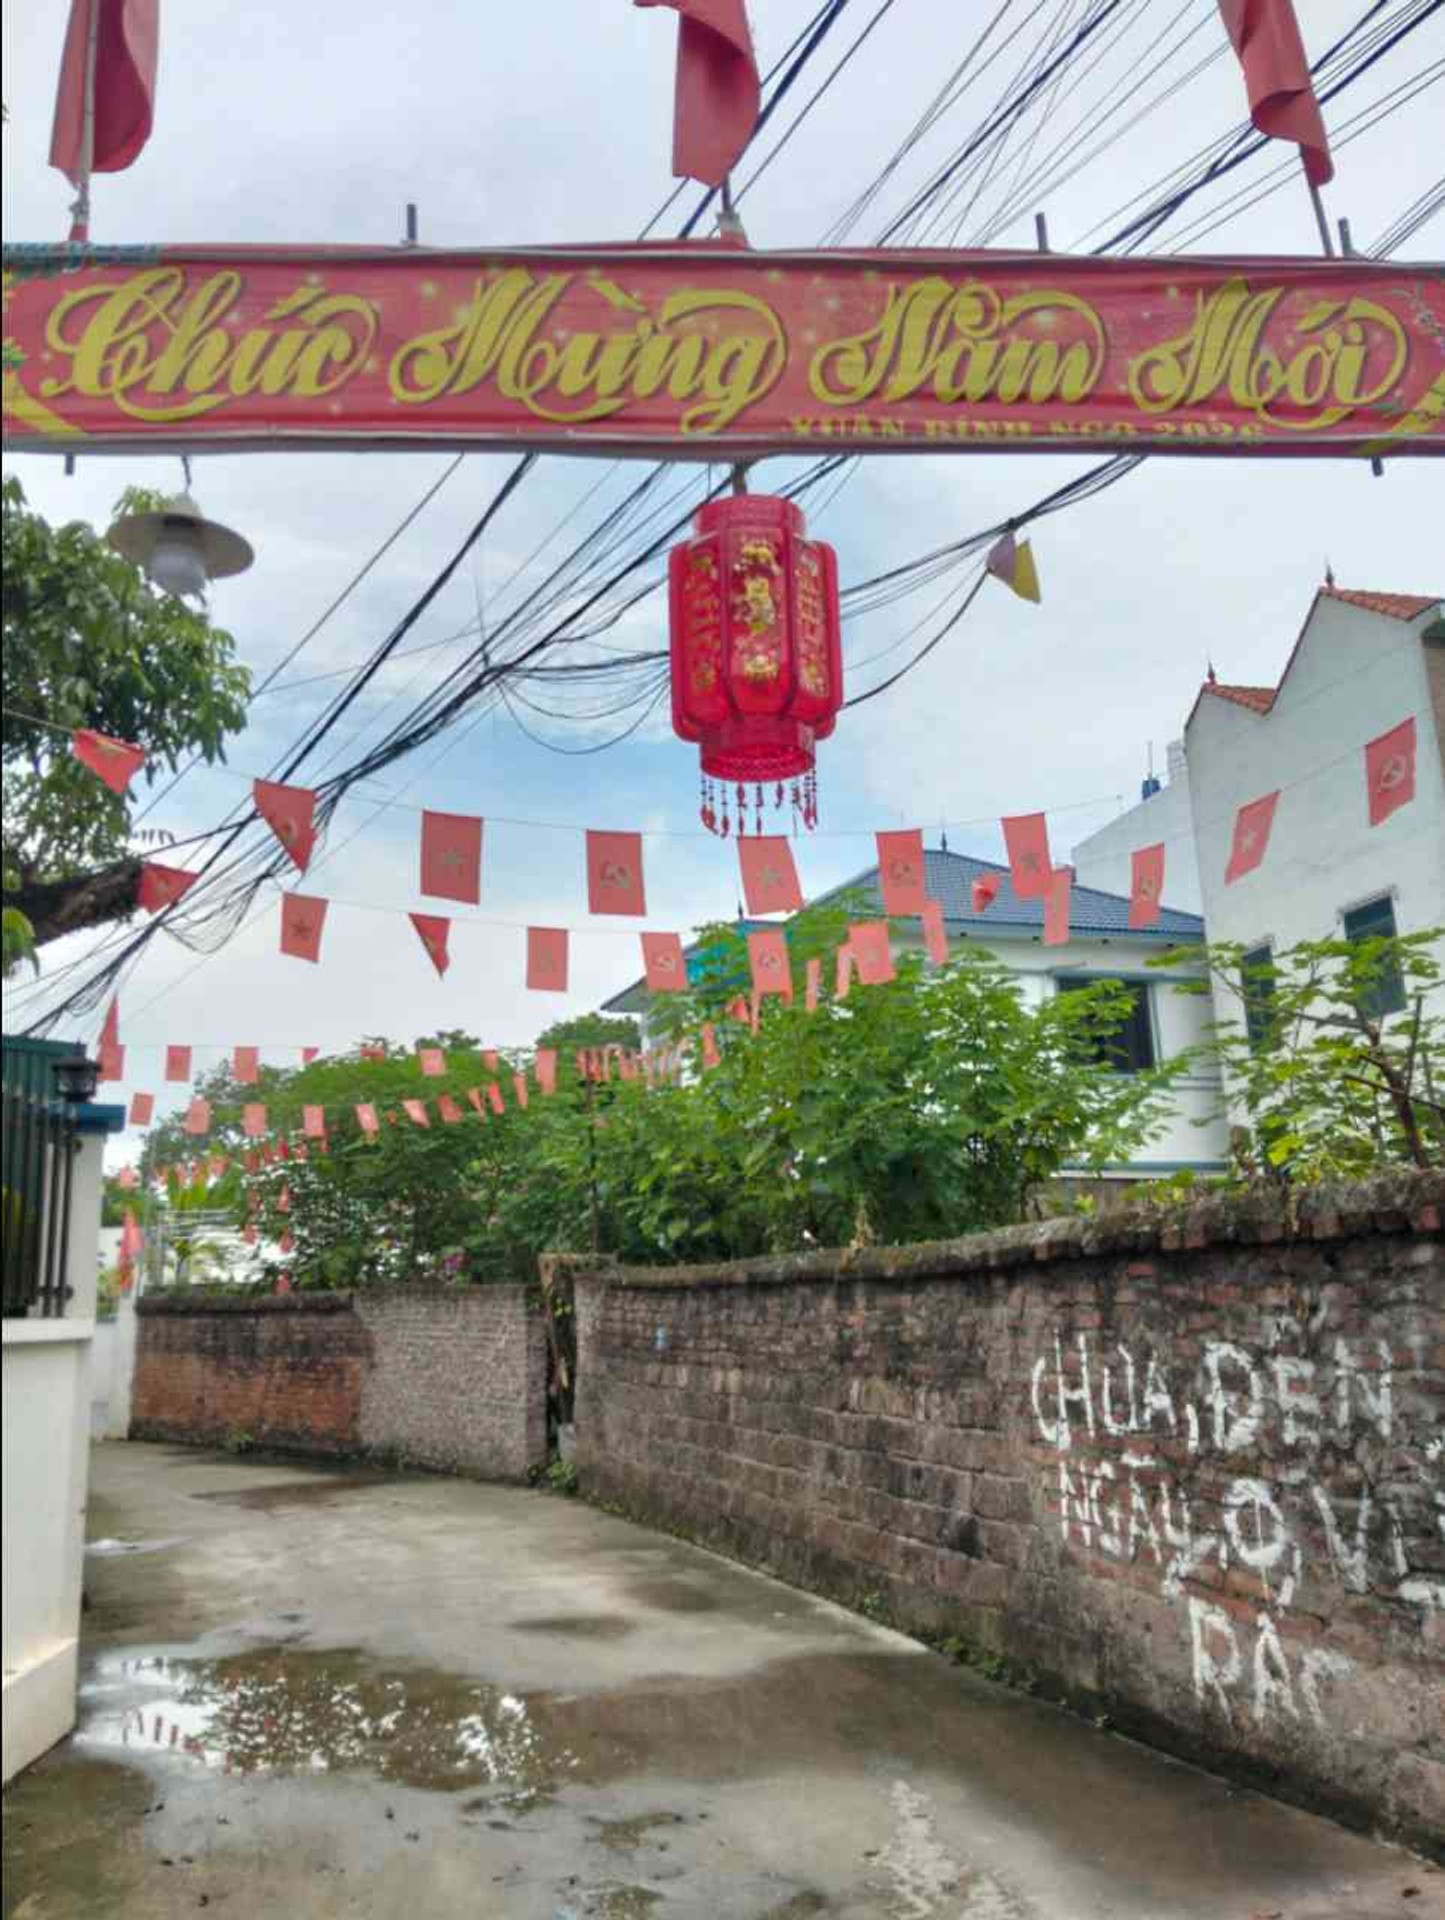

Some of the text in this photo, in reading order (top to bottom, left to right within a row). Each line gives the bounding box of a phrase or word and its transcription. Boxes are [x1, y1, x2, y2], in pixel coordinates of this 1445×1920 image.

[41, 267, 1408, 436] Chúc Mừng Năm Mới
